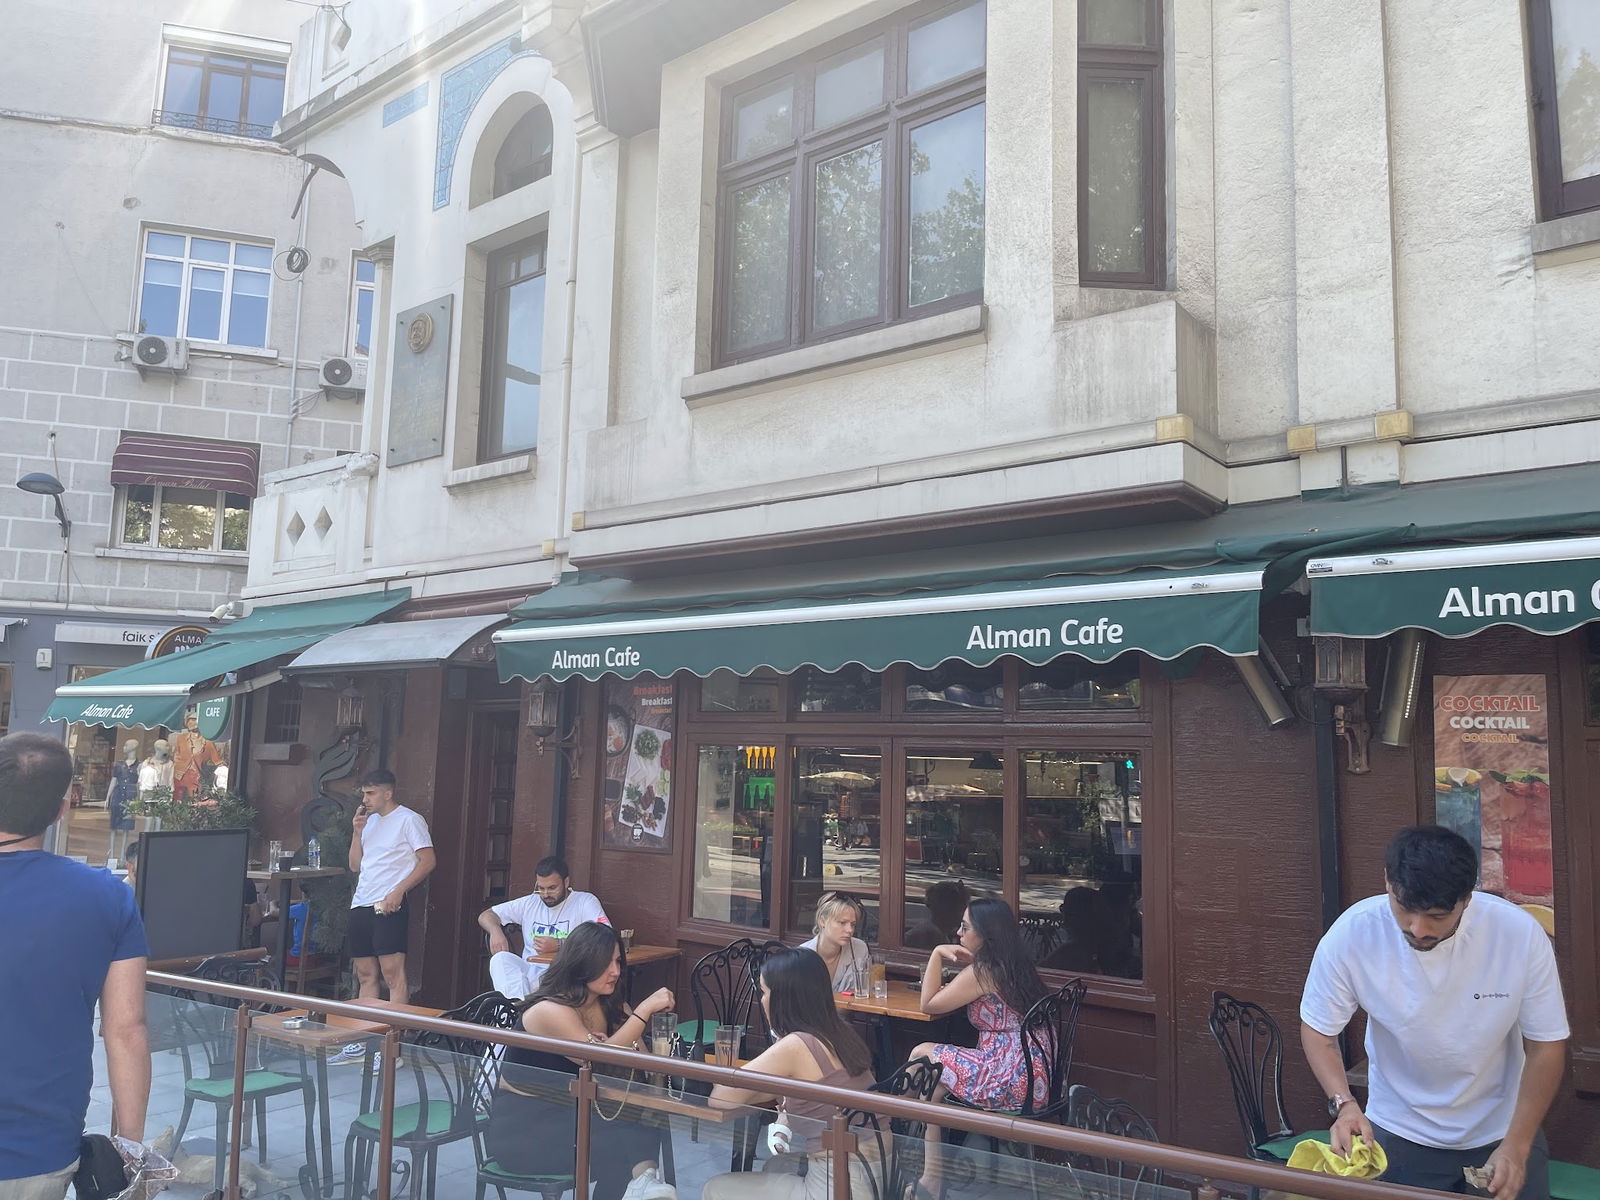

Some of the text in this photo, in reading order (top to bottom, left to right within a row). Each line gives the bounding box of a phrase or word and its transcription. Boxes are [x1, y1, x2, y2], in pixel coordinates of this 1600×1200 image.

[1438, 586, 1576, 618] Alman
[122, 631, 147, 643] faik
[174, 634, 205, 644] ALMA
[966, 617, 1124, 650] Alman Cafe
[551, 646, 641, 669] Alman Cafe
[1440, 695, 1541, 712] COCKTAIL
[80, 703, 134, 719] Alman Cafe
[205, 707, 221, 717] CAFE
[1449, 716, 1531, 729] COCKTAIL
[1461, 733, 1520, 743] COCKTAIL
